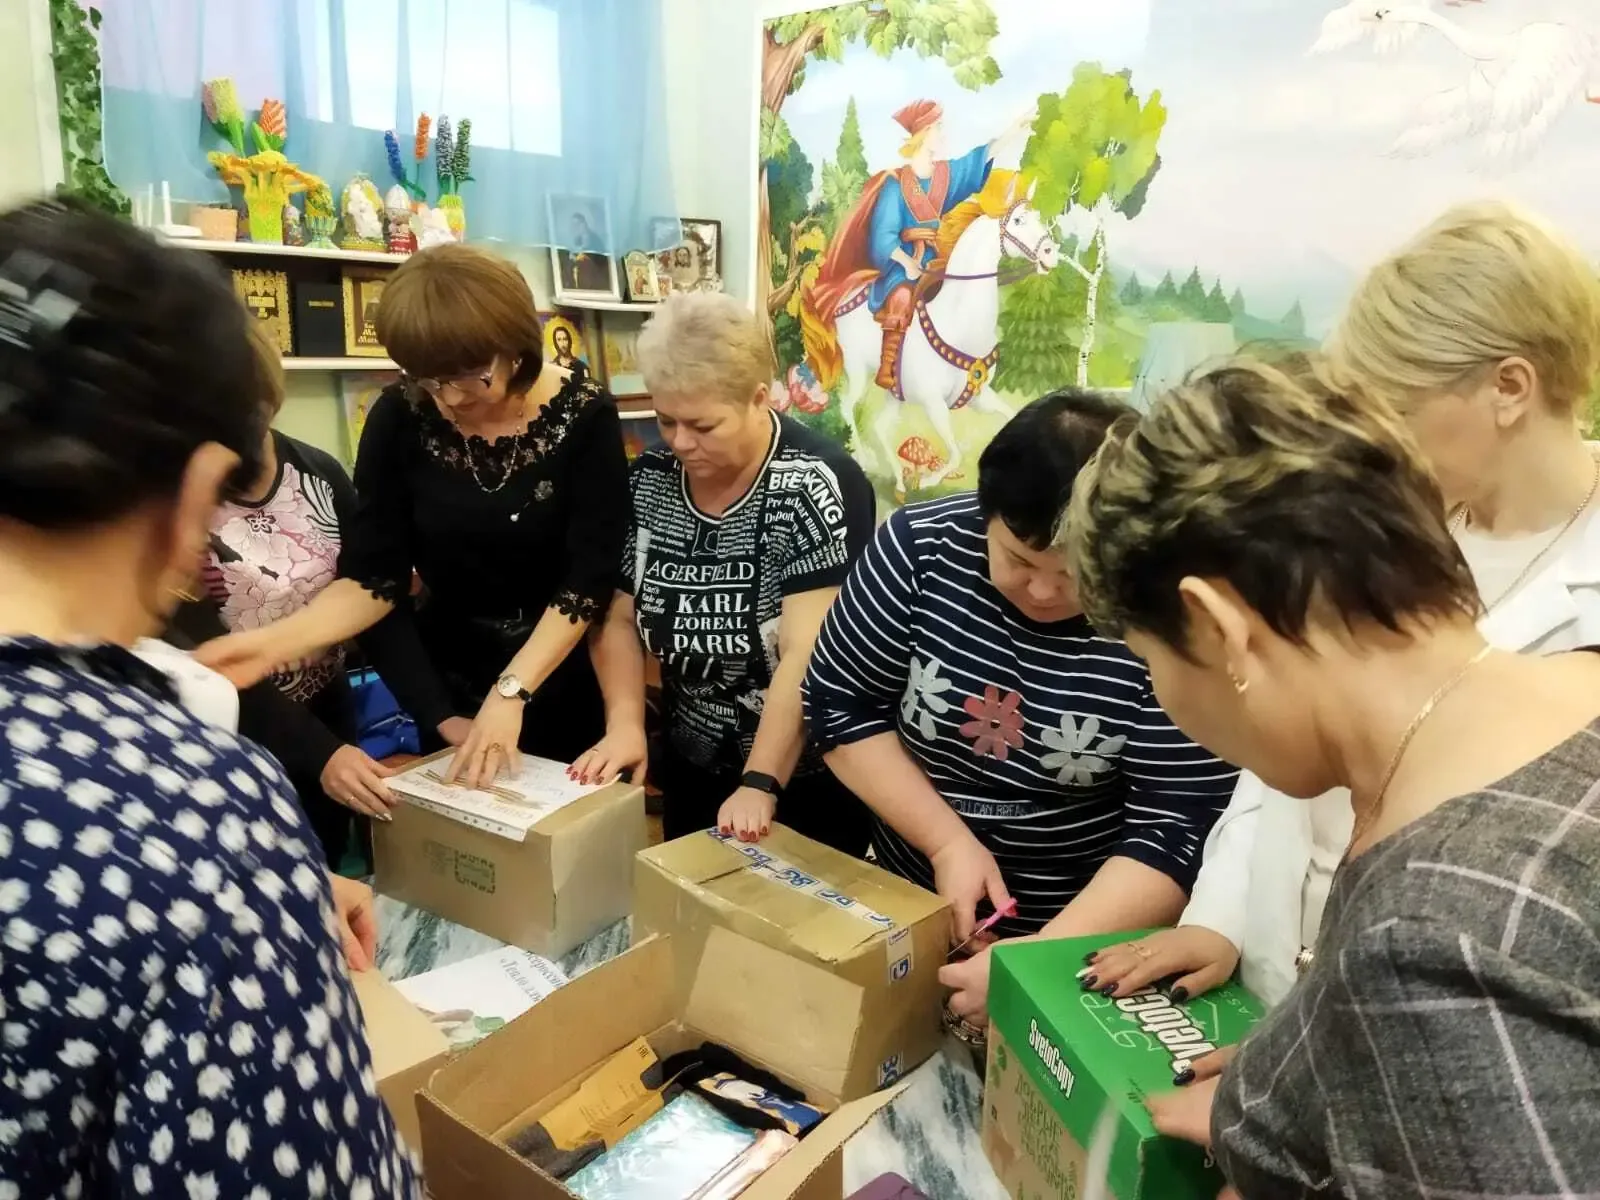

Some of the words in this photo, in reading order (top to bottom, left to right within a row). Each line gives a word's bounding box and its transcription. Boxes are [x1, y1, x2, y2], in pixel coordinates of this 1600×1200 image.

[675, 592, 751, 614] KARL
[672, 632, 752, 655] PARIS
[1029, 1018, 1075, 1099] SvetoCopy
